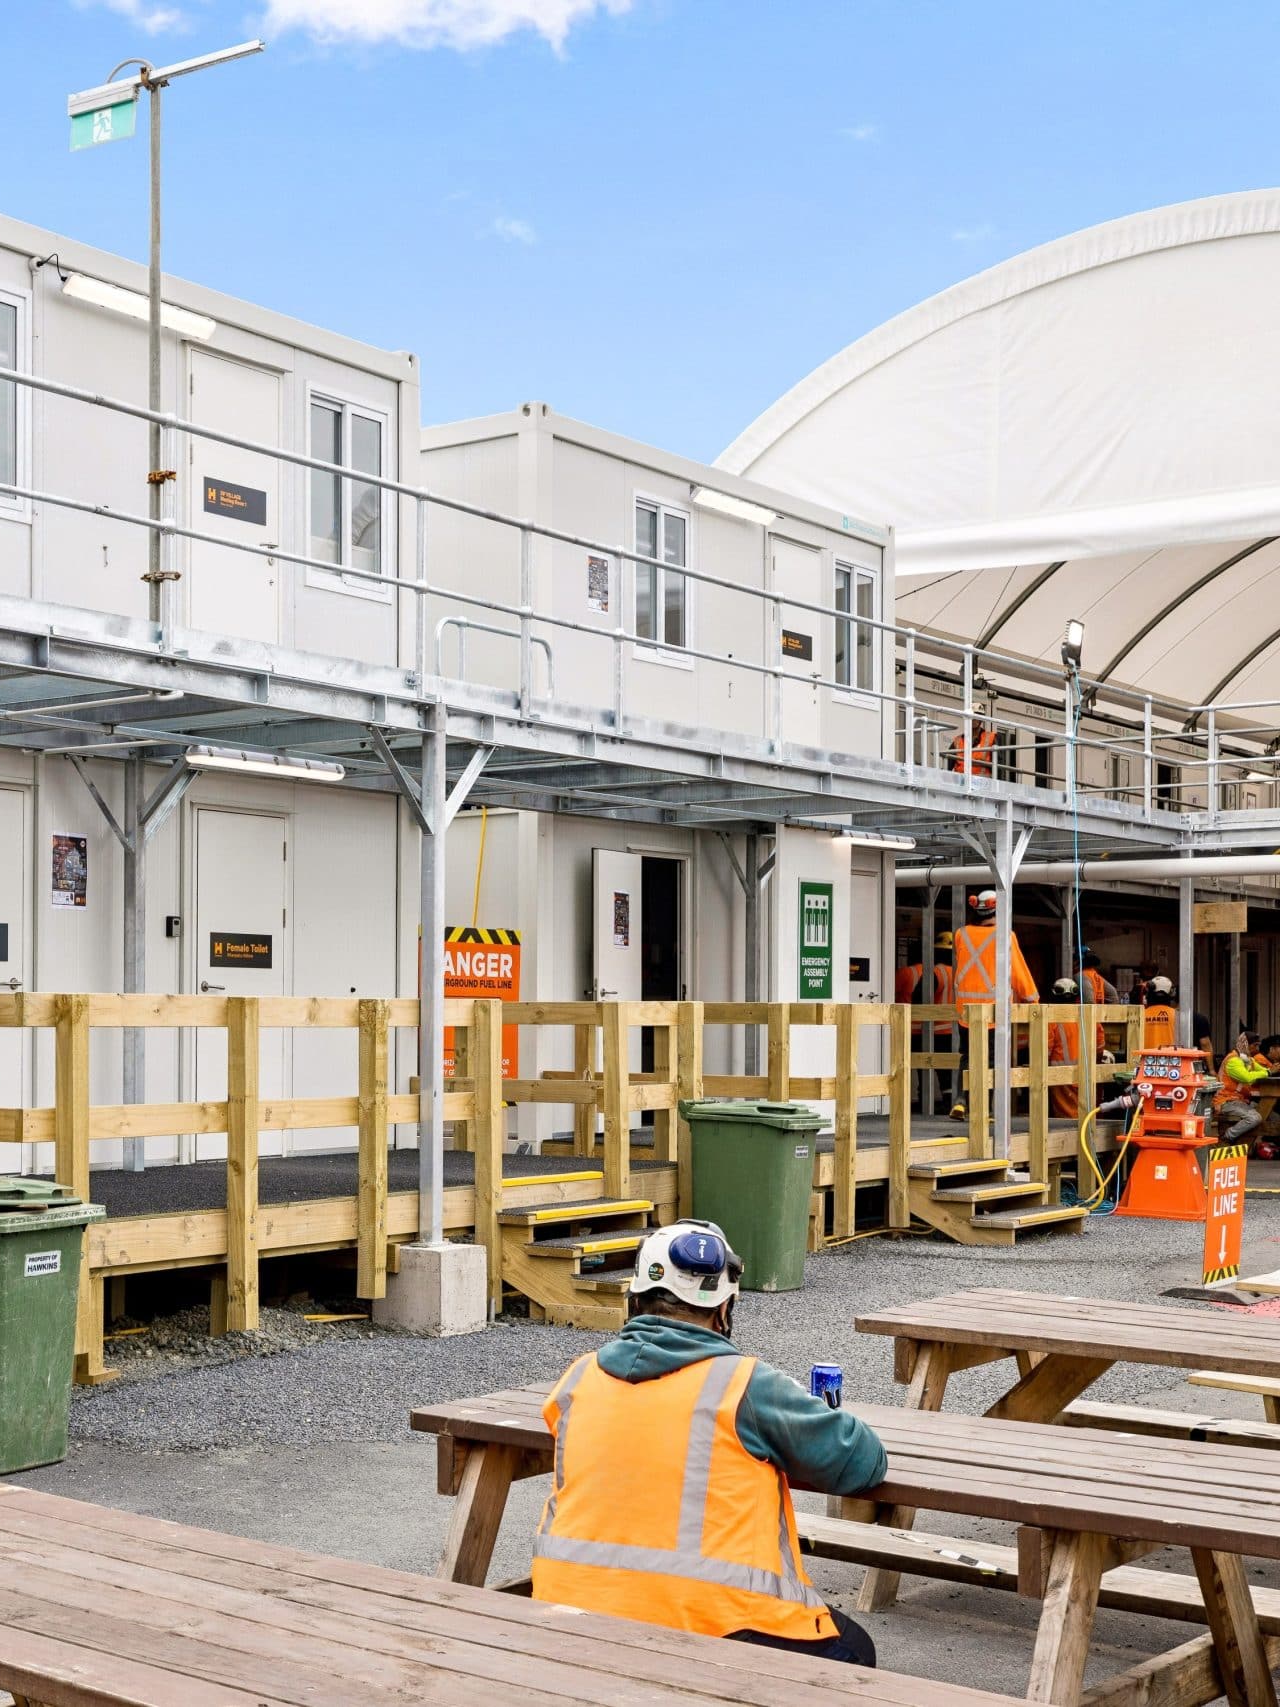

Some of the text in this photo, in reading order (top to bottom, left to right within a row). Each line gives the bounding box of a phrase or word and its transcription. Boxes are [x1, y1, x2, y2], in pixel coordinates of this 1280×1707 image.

[226, 943, 250, 953] Female
[250, 944, 269, 954] Toilet
[443, 951, 513, 978] ANGER
[801, 957, 831, 966] EMERGENCY
[803, 967, 829, 977] ASSEMBLY
[479, 980, 496, 989] FUEL
[497, 981, 513, 990] LINE
[808, 978, 824, 988] POINT
[1213, 1165, 1240, 1191] FUEL
[1213, 1192, 1239, 1217] LINE
[28, 1255, 51, 1263] PROPERTY
[27, 1262, 58, 1273] HAWKINS
